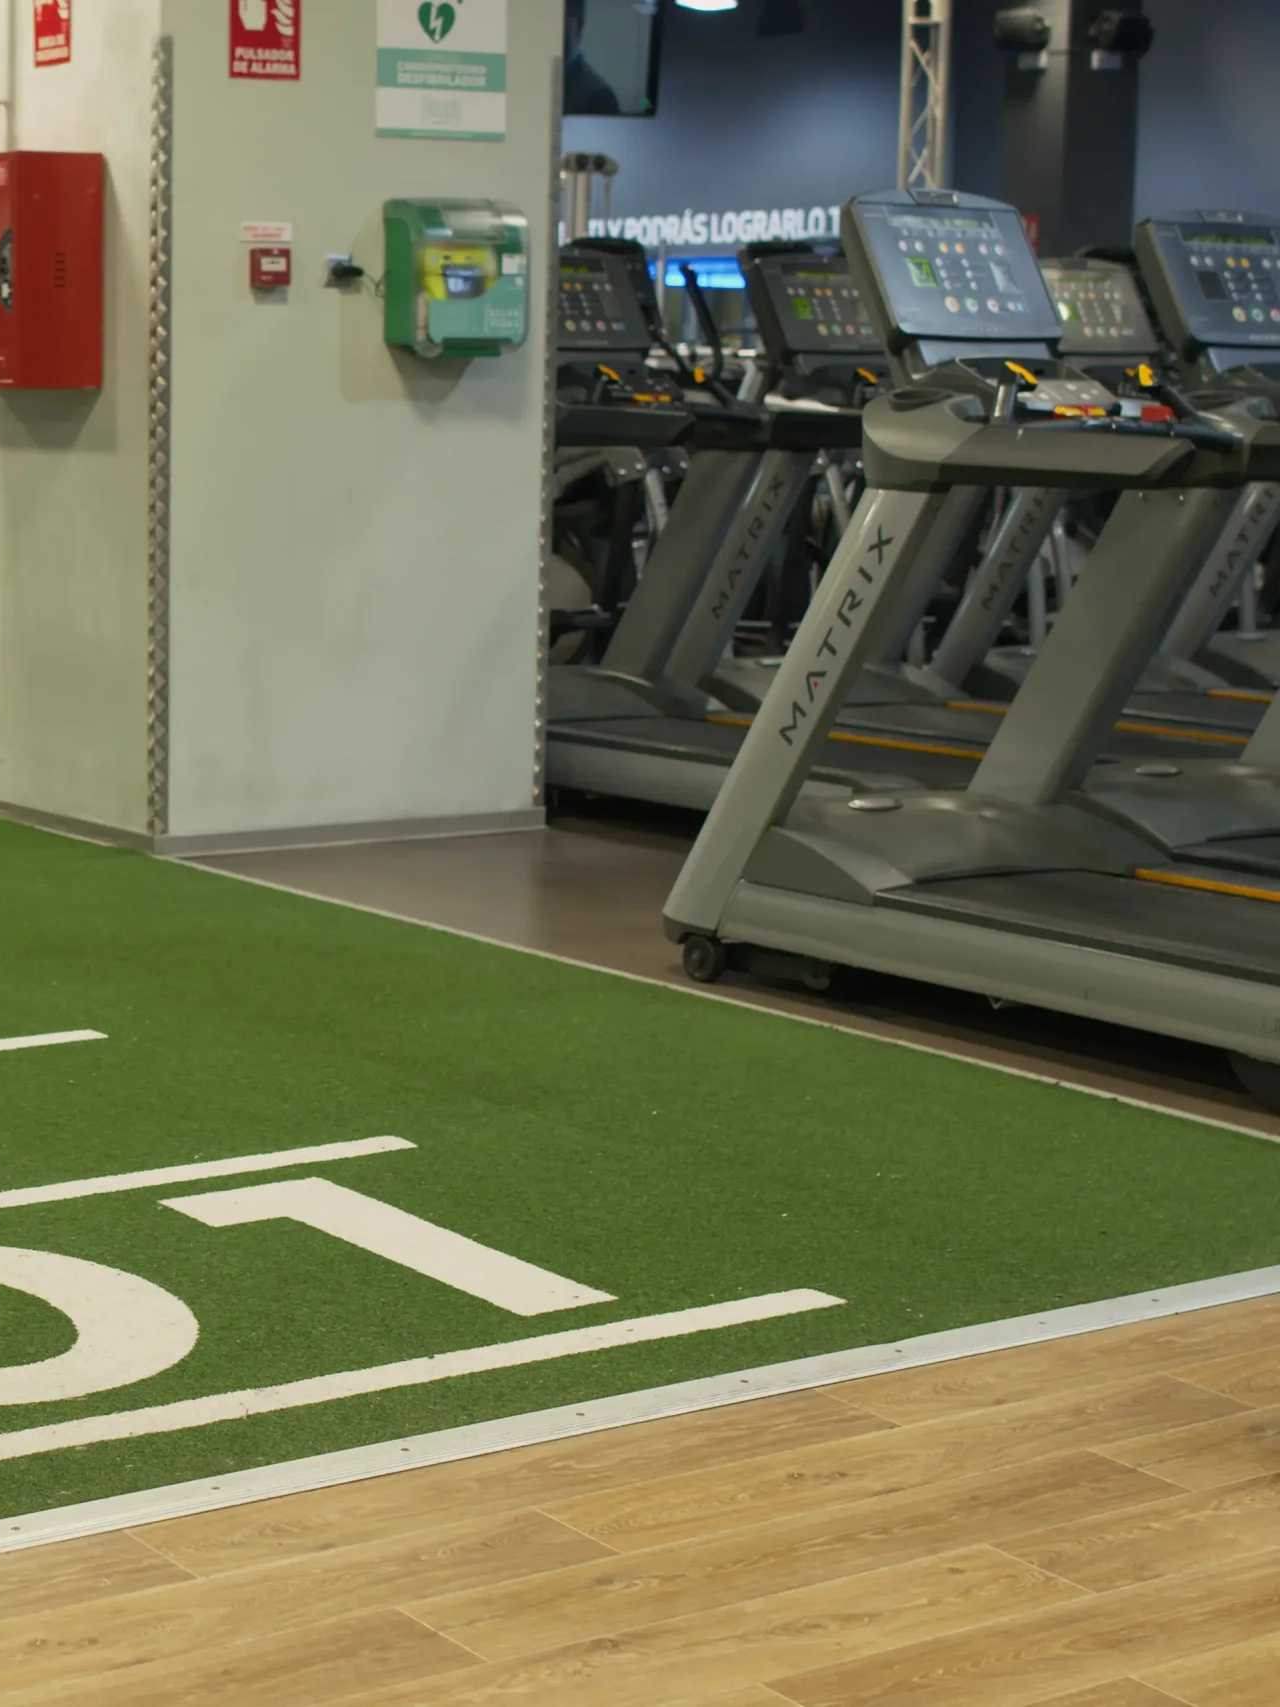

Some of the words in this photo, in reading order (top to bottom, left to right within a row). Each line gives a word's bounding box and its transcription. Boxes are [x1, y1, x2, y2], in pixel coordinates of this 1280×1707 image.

[232, 61, 248, 73] DE
[250, 61, 296, 75] ALARMA
[235, 47, 294, 61] PULSADOR
[623, 207, 709, 247] PODRÁS
[710, 206, 827, 243] LOGRARLO
[711, 475, 785, 619] MATRIX
[779, 524, 895, 746] MATRIX
